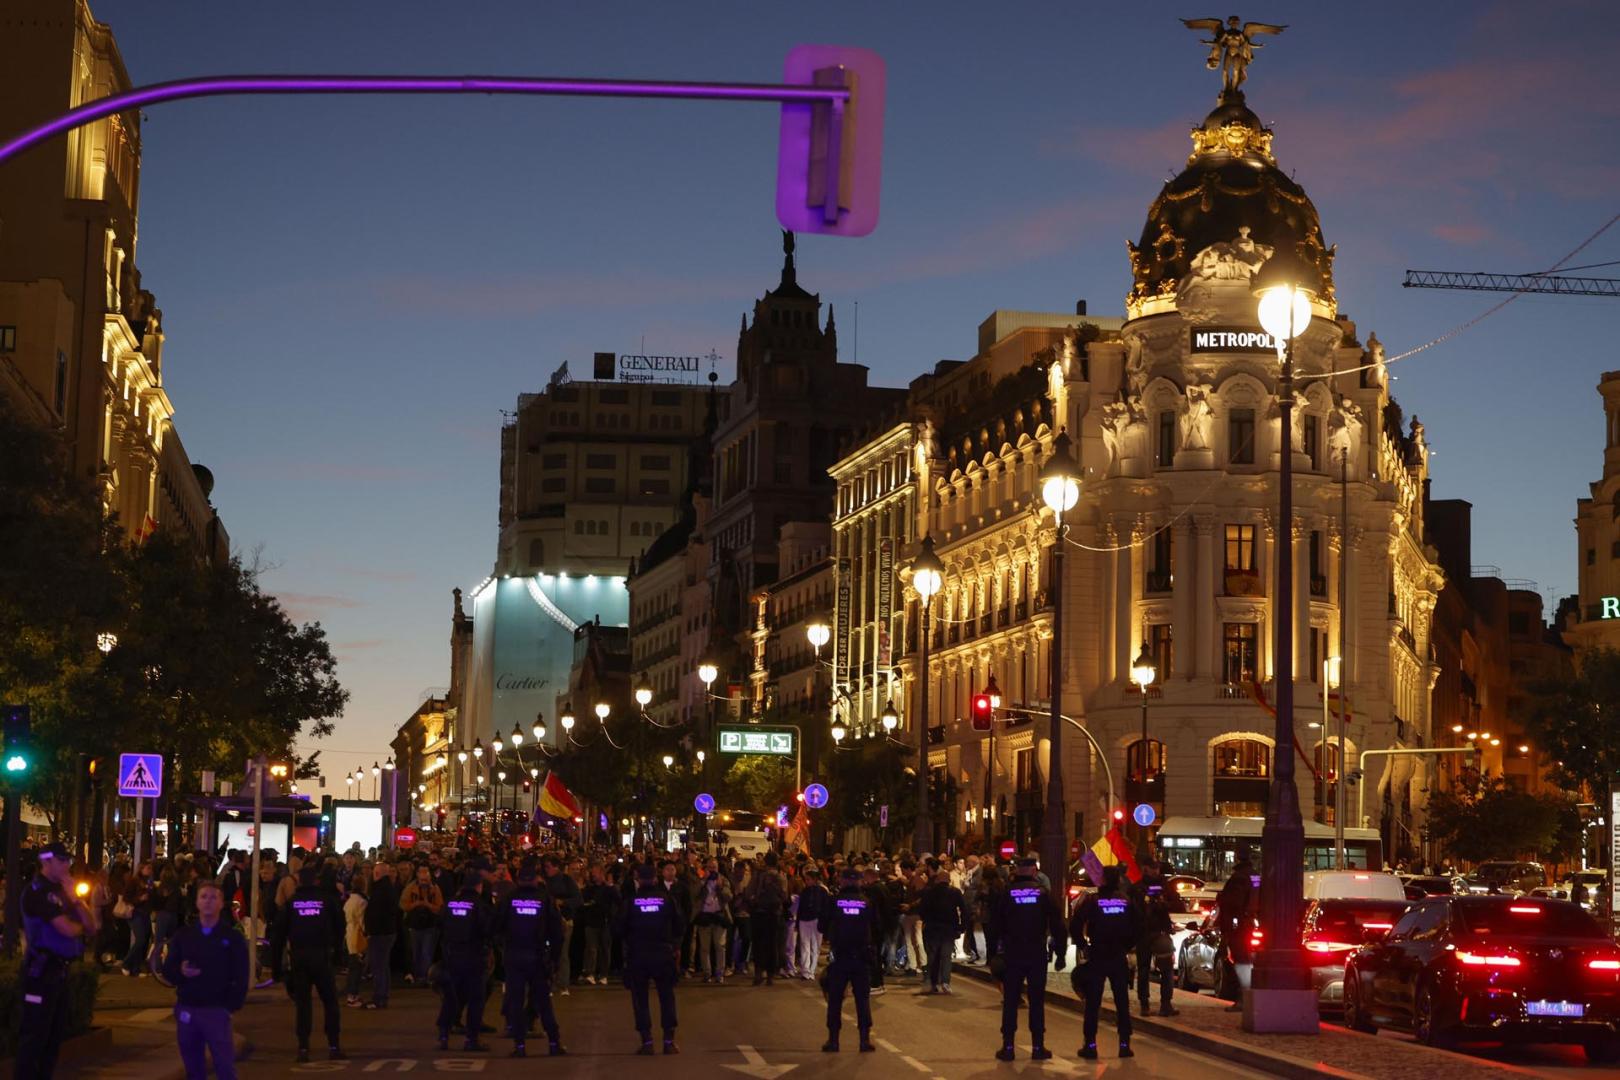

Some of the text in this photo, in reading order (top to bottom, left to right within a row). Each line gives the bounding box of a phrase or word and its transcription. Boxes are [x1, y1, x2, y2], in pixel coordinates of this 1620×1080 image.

[620, 355, 699, 371] GENERALI
[881, 552, 891, 569] VIVAS
[880, 605, 889, 618] NOS
[838, 588, 849, 675] POR SER MUJERES
[496, 672, 549, 690] Cartier
